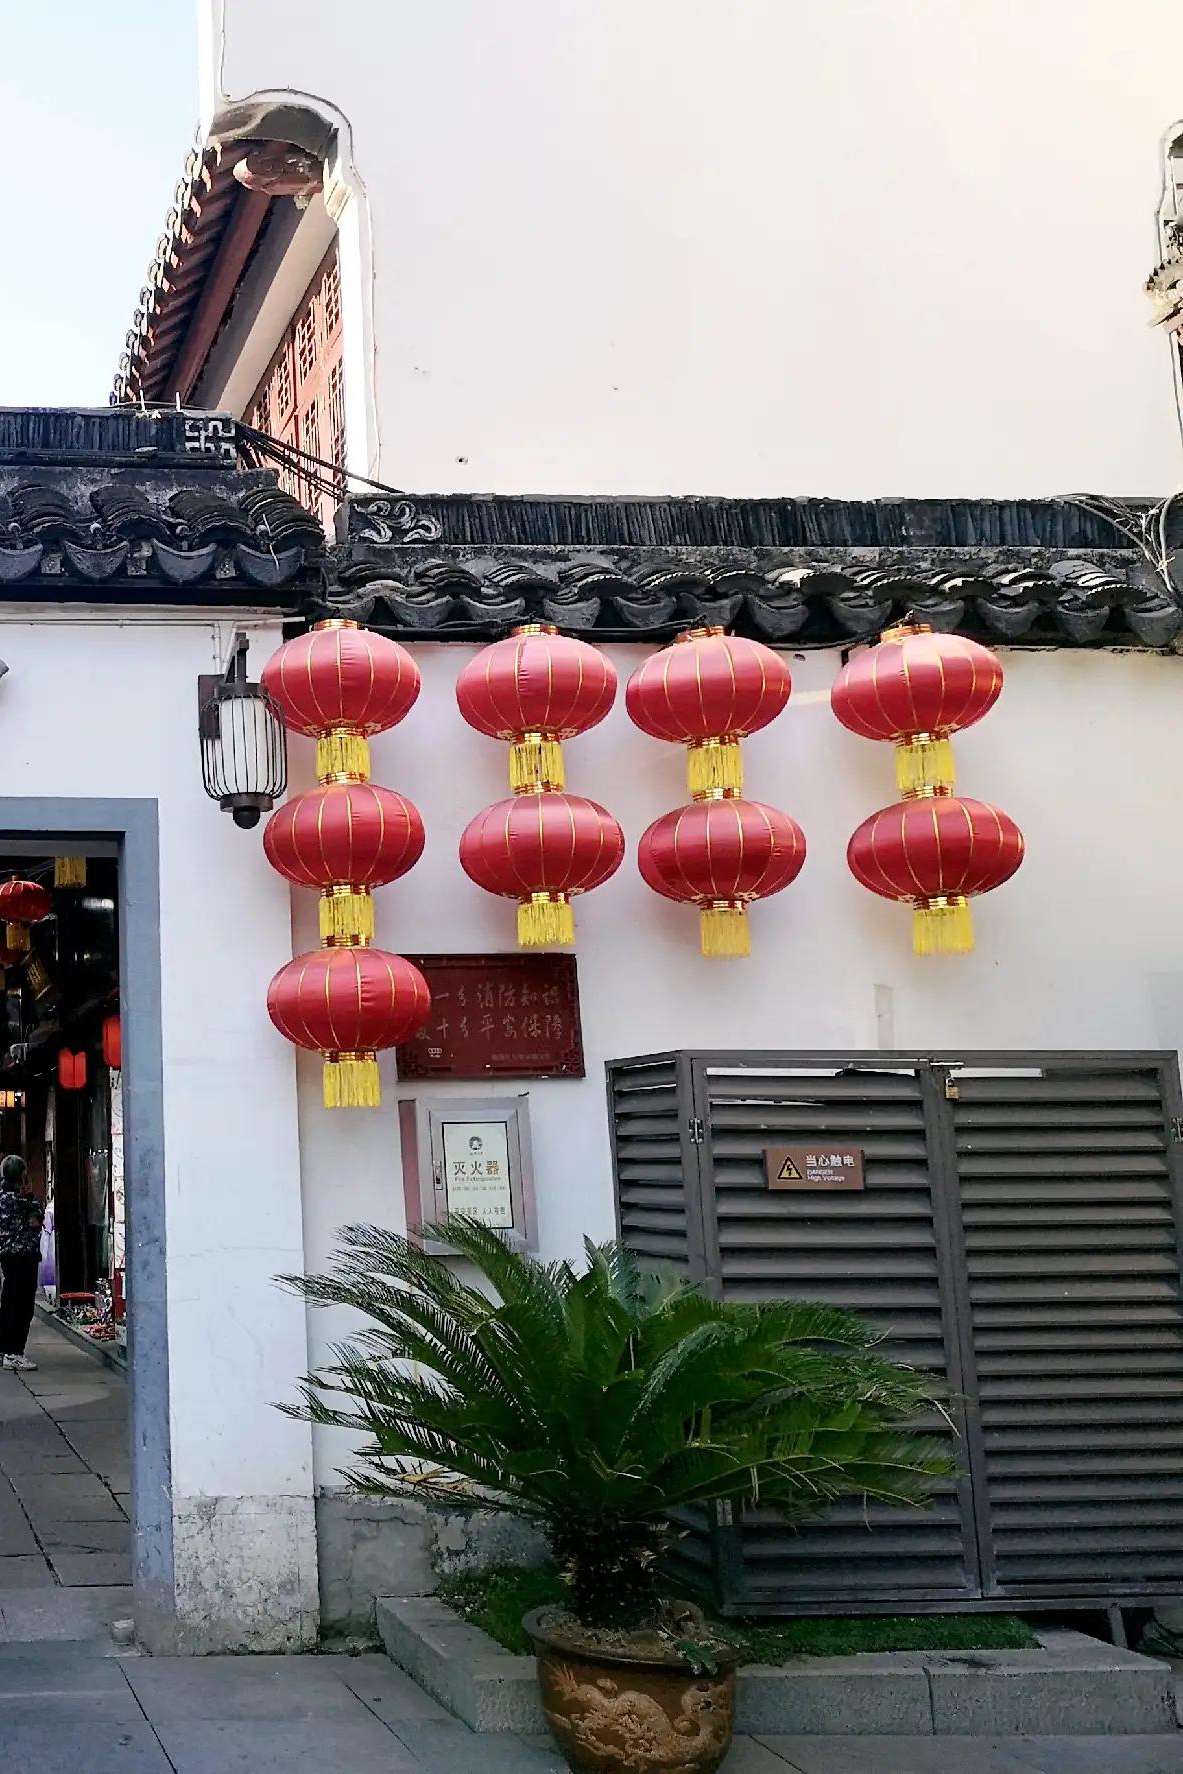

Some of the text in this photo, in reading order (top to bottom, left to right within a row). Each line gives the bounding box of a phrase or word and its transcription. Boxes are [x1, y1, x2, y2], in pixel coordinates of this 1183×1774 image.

[805, 1154, 855, 1167] 当心触电
[453, 1160, 500, 1176] 灭火器
